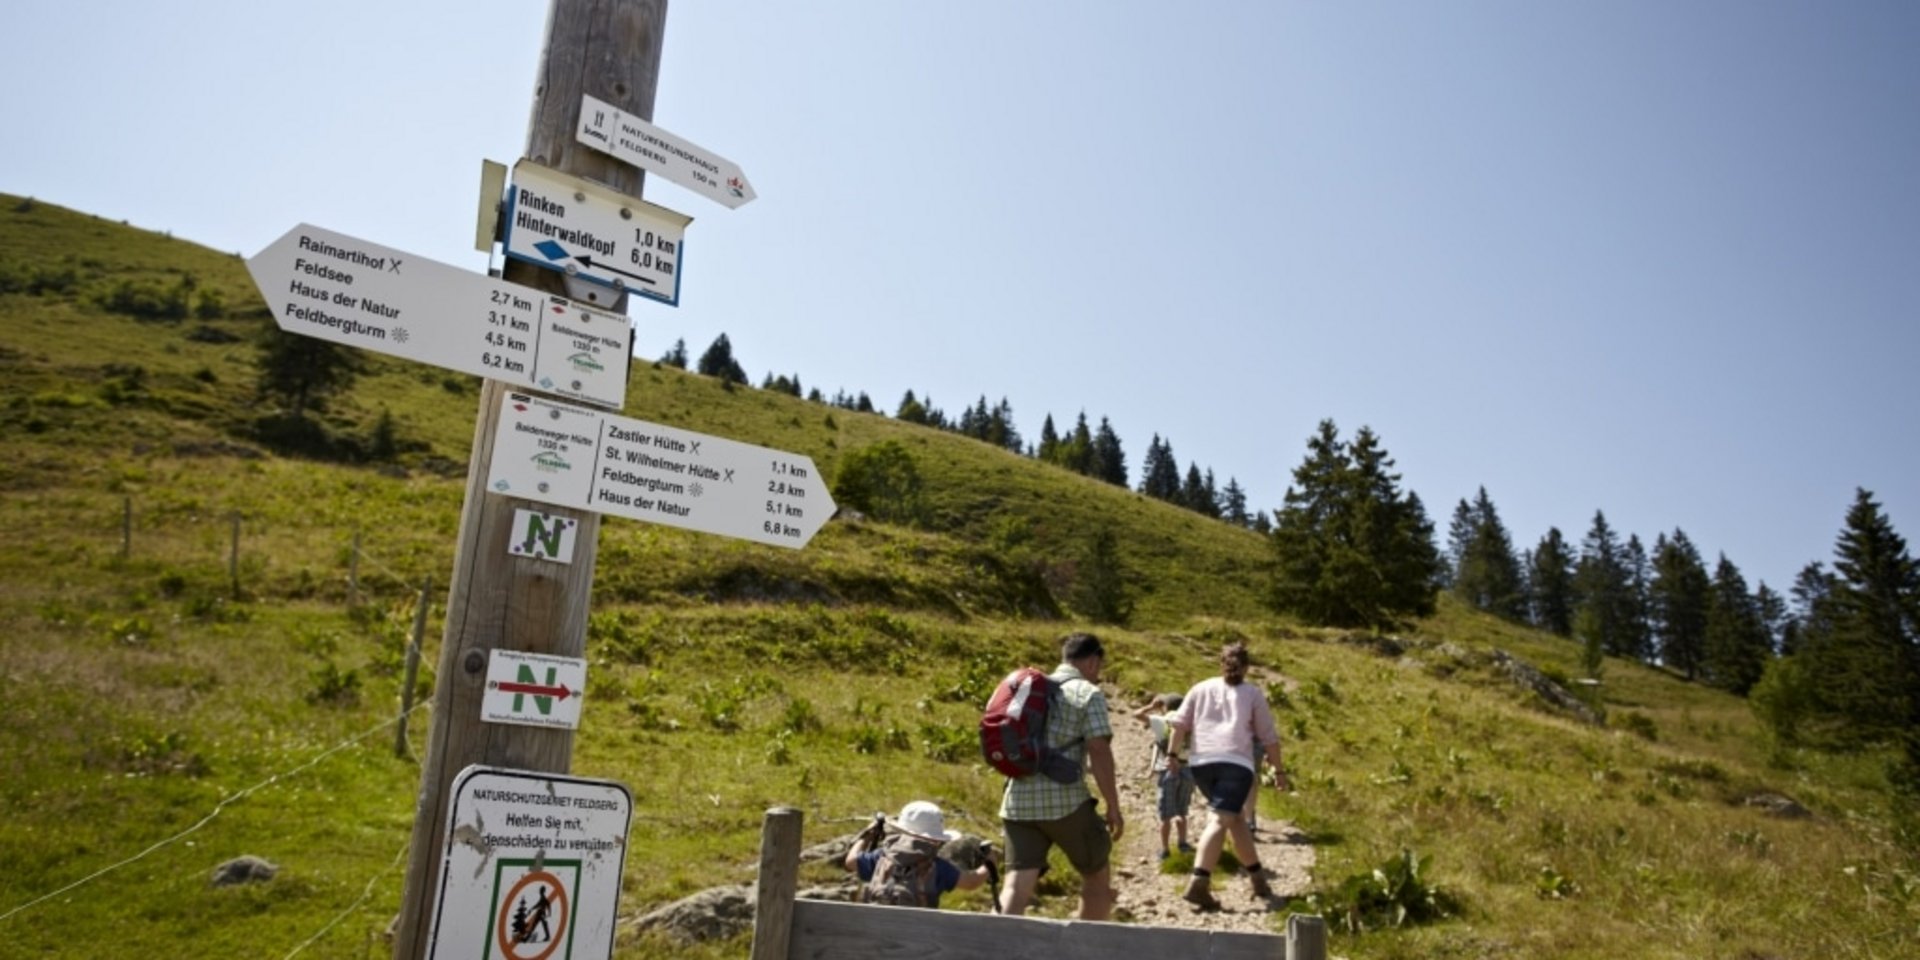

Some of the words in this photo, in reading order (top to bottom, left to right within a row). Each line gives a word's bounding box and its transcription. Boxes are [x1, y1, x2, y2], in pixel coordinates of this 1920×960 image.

[619, 138, 667, 165] FELDBERG
[621, 123, 719, 174] NATURFREUNDEHAUS
[692, 170, 708, 183] 150
[708, 180, 718, 188] m
[519, 189, 565, 218] Rinken
[516, 211, 616, 256] Hinterwaldkopf
[634, 228, 654, 247] 1,0
[657, 235, 676, 255] km
[299, 235, 385, 270] Raimartihof
[631, 248, 652, 269] 6,0
[655, 254, 674, 275] km
[294, 258, 353, 285] Feldsee
[289, 279, 329, 301] Haus
[332, 291, 357, 308] der
[361, 298, 401, 319] Natur
[491, 290, 510, 306] 2,7
[513, 296, 532, 312] km
[285, 303, 386, 339] Feldbergturm
[488, 311, 507, 327] 3,1
[510, 316, 530, 332] km
[552, 322, 601, 343] Baldenweger
[485, 331, 505, 347] 4,5
[507, 337, 526, 352] km
[482, 352, 502, 369] 6,2
[504, 358, 525, 373] km
[515, 421, 569, 441] Baldenweger
[608, 426, 651, 444] Zastler
[654, 435, 686, 453] Hütte
[605, 446, 621, 461] St.
[626, 450, 686, 474] Wilhelmer
[688, 464, 720, 481] Hütte
[772, 461, 787, 474] 1,1
[790, 464, 807, 478] km
[602, 467, 683, 495] Feldbergturm
[768, 481, 785, 495] 2,8
[788, 484, 805, 498] km
[599, 488, 631, 505] Haus
[634, 495, 654, 510] der
[657, 499, 690, 517] Natur
[766, 500, 783, 515] 5,1
[785, 504, 803, 518] km
[525, 514, 563, 557] N
[764, 521, 781, 535] 6,8
[783, 524, 801, 538] km
[513, 664, 556, 715] N
[573, 798, 618, 811] FELDBERG
[506, 812, 543, 828] Helfen
[544, 815, 561, 830] Sie
[481, 832, 552, 849] denschäden
[554, 839, 567, 850] zu
